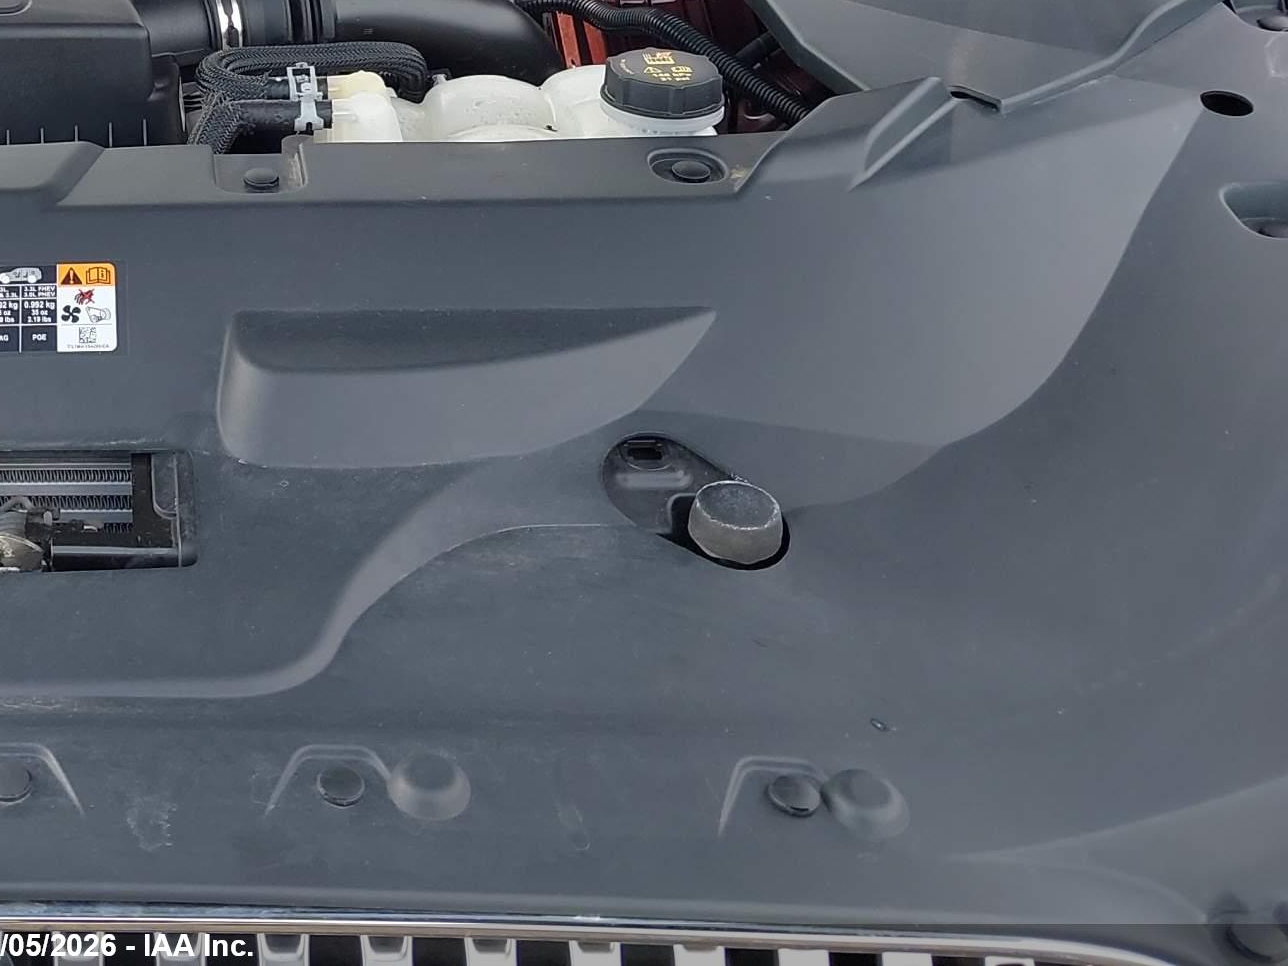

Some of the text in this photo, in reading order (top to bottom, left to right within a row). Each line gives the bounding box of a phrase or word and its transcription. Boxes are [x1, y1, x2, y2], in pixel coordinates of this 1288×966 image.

[9, 301, 18, 310] kg
[24, 300, 55, 310] 0.992 kg
